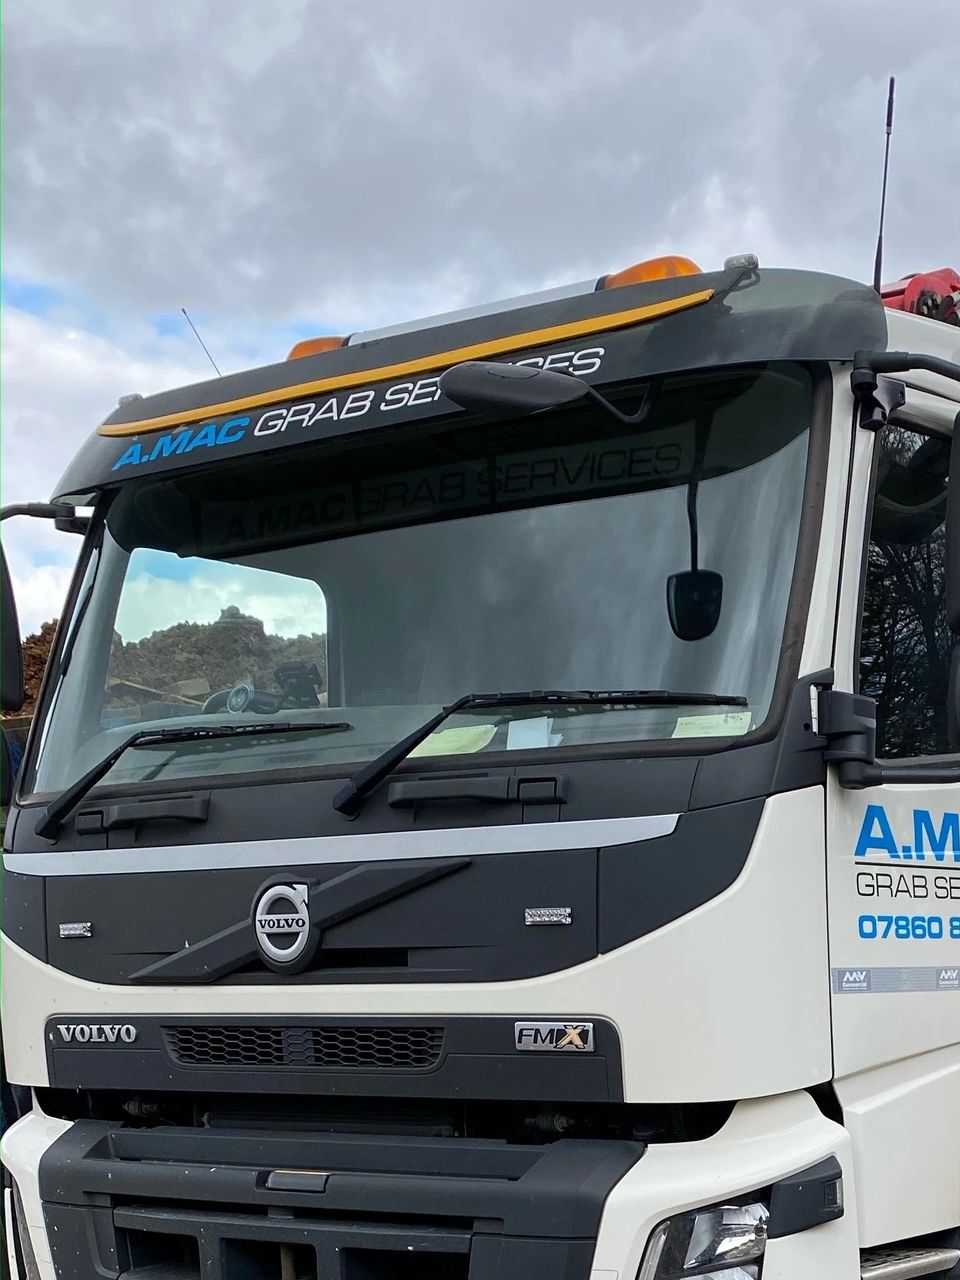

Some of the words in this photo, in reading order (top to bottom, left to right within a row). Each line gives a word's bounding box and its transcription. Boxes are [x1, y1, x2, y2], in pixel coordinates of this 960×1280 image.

[112, 416, 250, 471] A.MAC
[254, 390, 375, 437] GRAB
[380, 347, 605, 411] SEES
[356, 472, 465, 517] GRAB
[477, 443, 683, 499] SERVICES
[856, 872, 928, 899] GRAB
[257, 918, 306, 929] VOLVO
[858, 914, 944, 940] 07860
[57, 1024, 137, 1042] VOLVO
[517, 1025, 589, 1049] FMX
